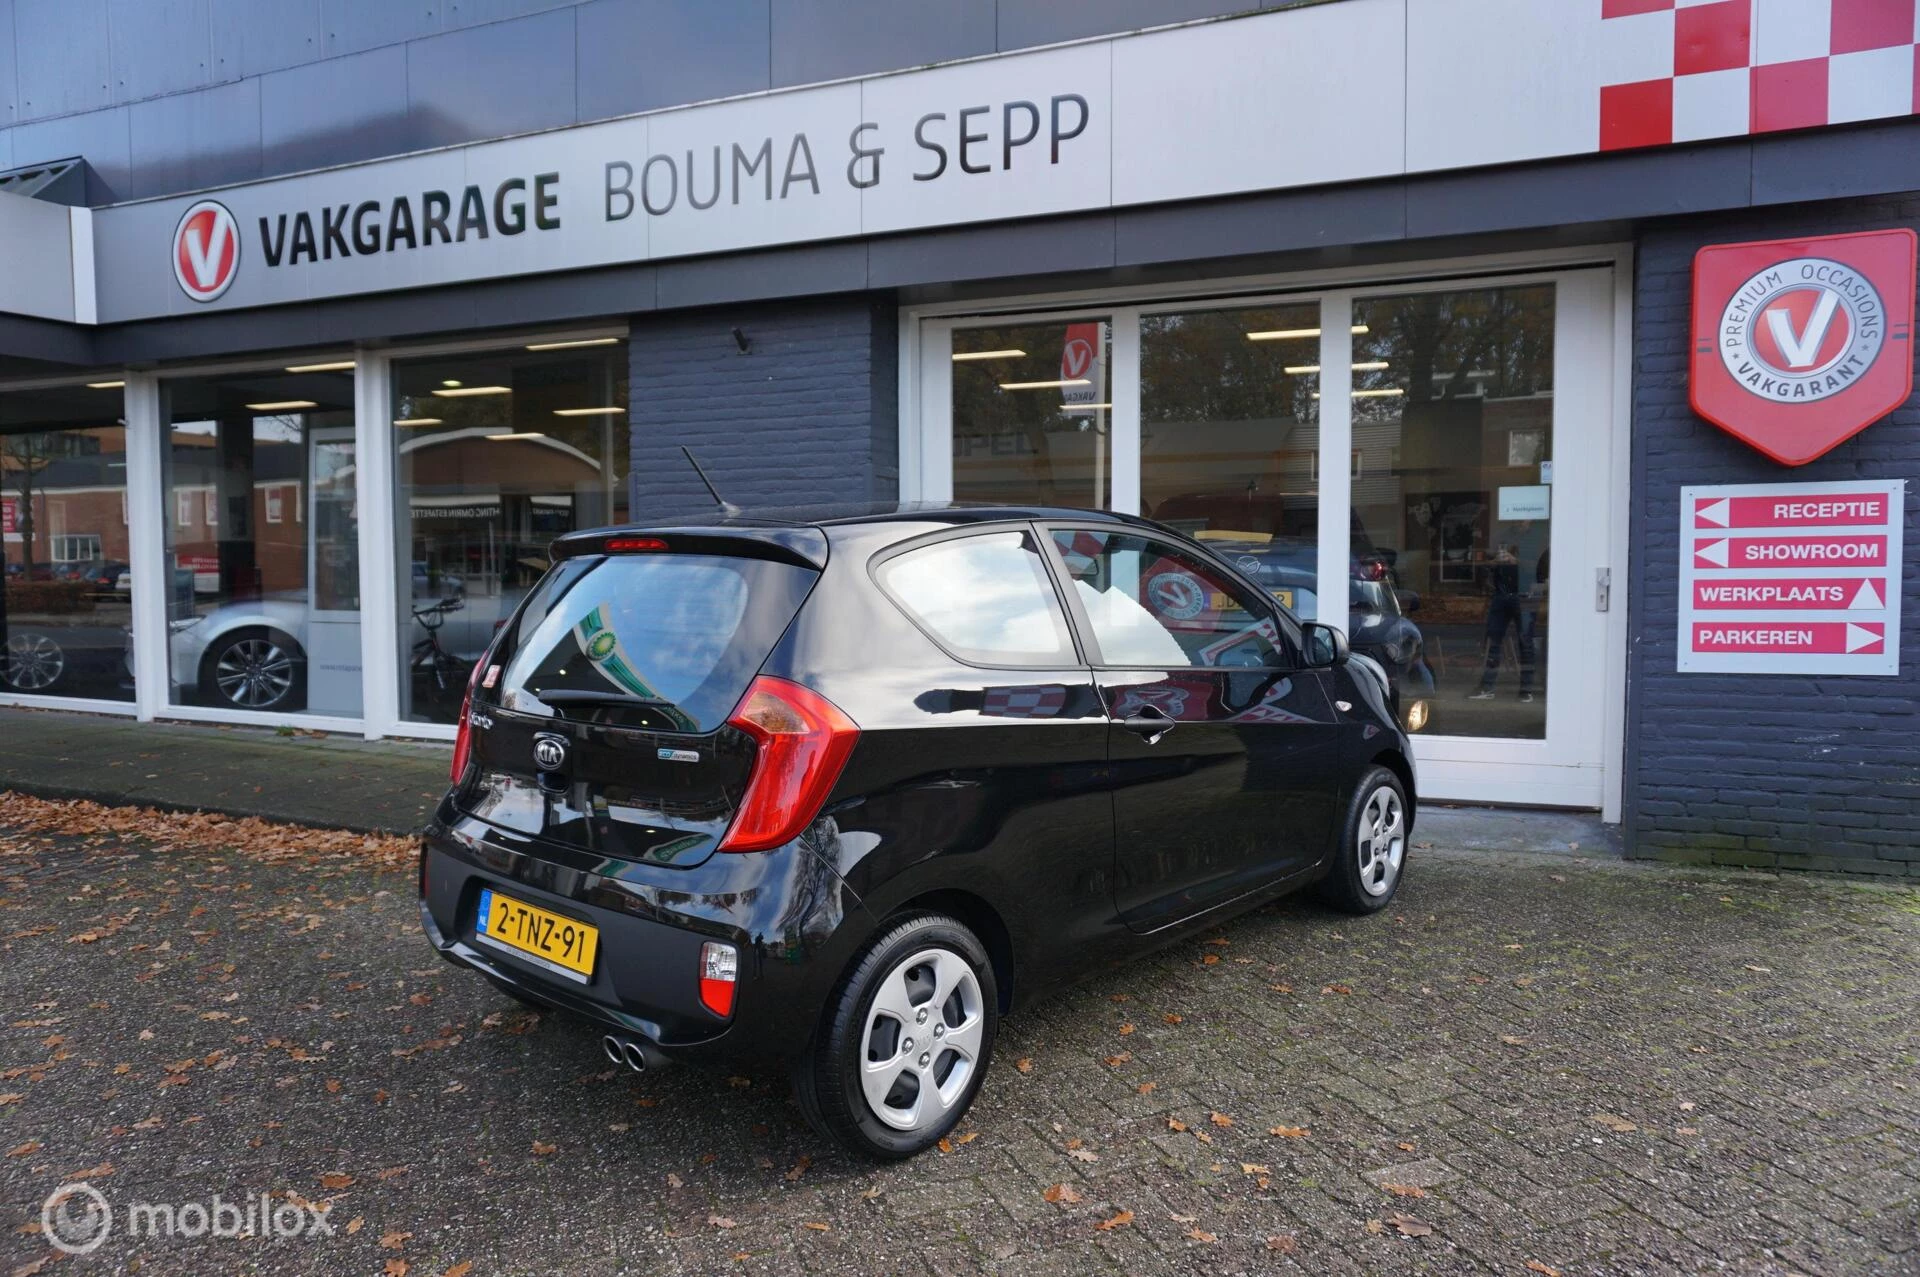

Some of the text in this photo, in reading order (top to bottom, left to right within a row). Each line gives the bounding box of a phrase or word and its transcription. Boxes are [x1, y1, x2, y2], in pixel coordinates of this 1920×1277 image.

[259, 172, 560, 267] VAKGARAGE
[605, 132, 820, 222] BOUMA
[847, 122, 885, 189] &
[913, 93, 1089, 182] SEPP
[1726, 264, 1878, 347] PREMIUM OCCASIONS
[1738, 355, 1864, 397] VAKGARANT
[1774, 502, 1880, 519] RECEPTIE
[1745, 543, 1878, 560] SHOWROOM
[1700, 587, 1843, 602] WERKPLAATS
[1700, 630, 1813, 645] PARKEREN
[497, 902, 585, 963] 2-TNZ-91
